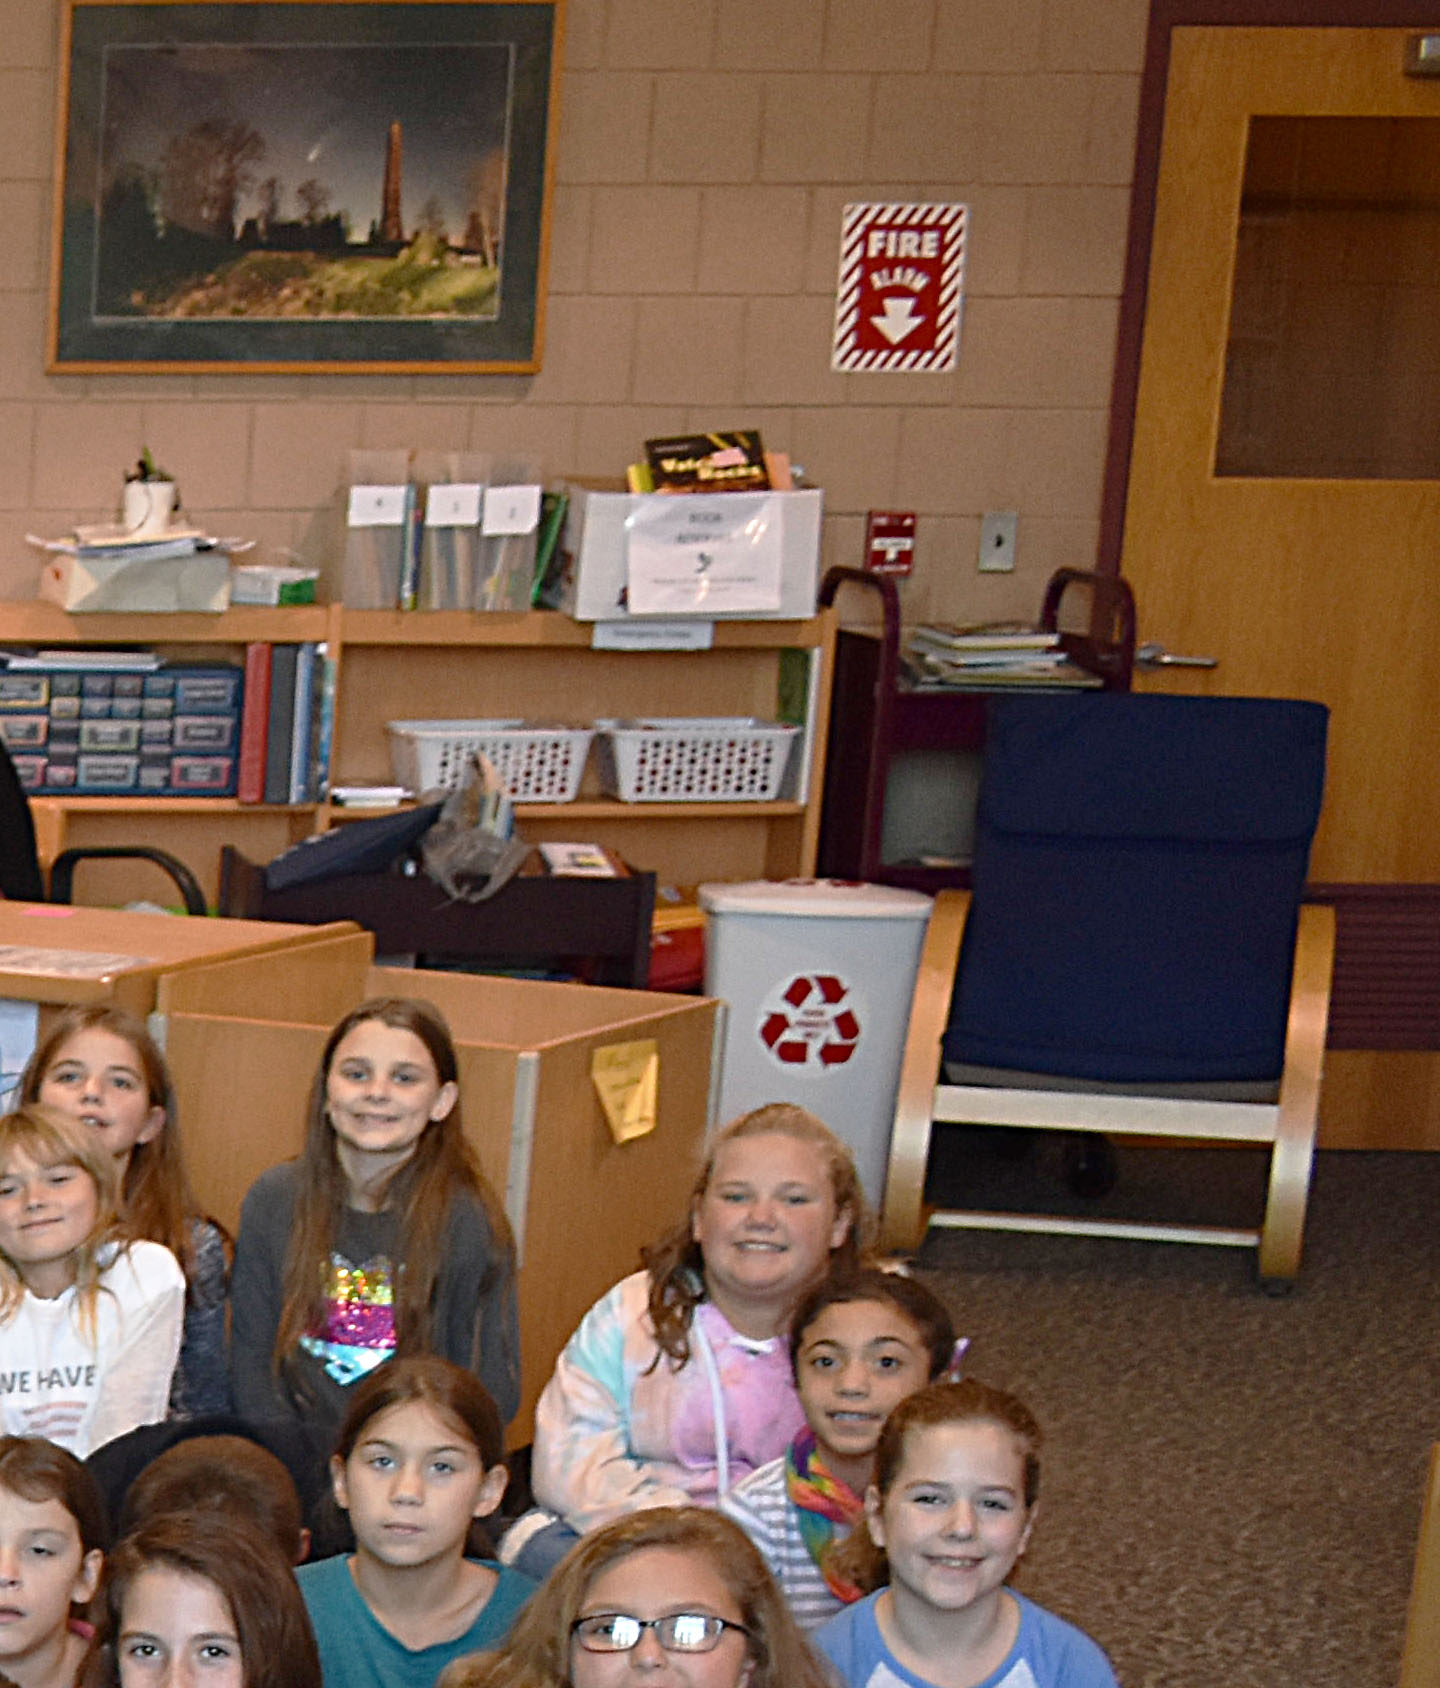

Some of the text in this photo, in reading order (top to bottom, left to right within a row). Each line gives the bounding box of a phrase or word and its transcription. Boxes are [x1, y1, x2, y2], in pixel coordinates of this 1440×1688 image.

[867, 230, 940, 259] FIRE
[871, 266, 929, 290] ALARM
[37, 1364, 97, 1389] HAVE
